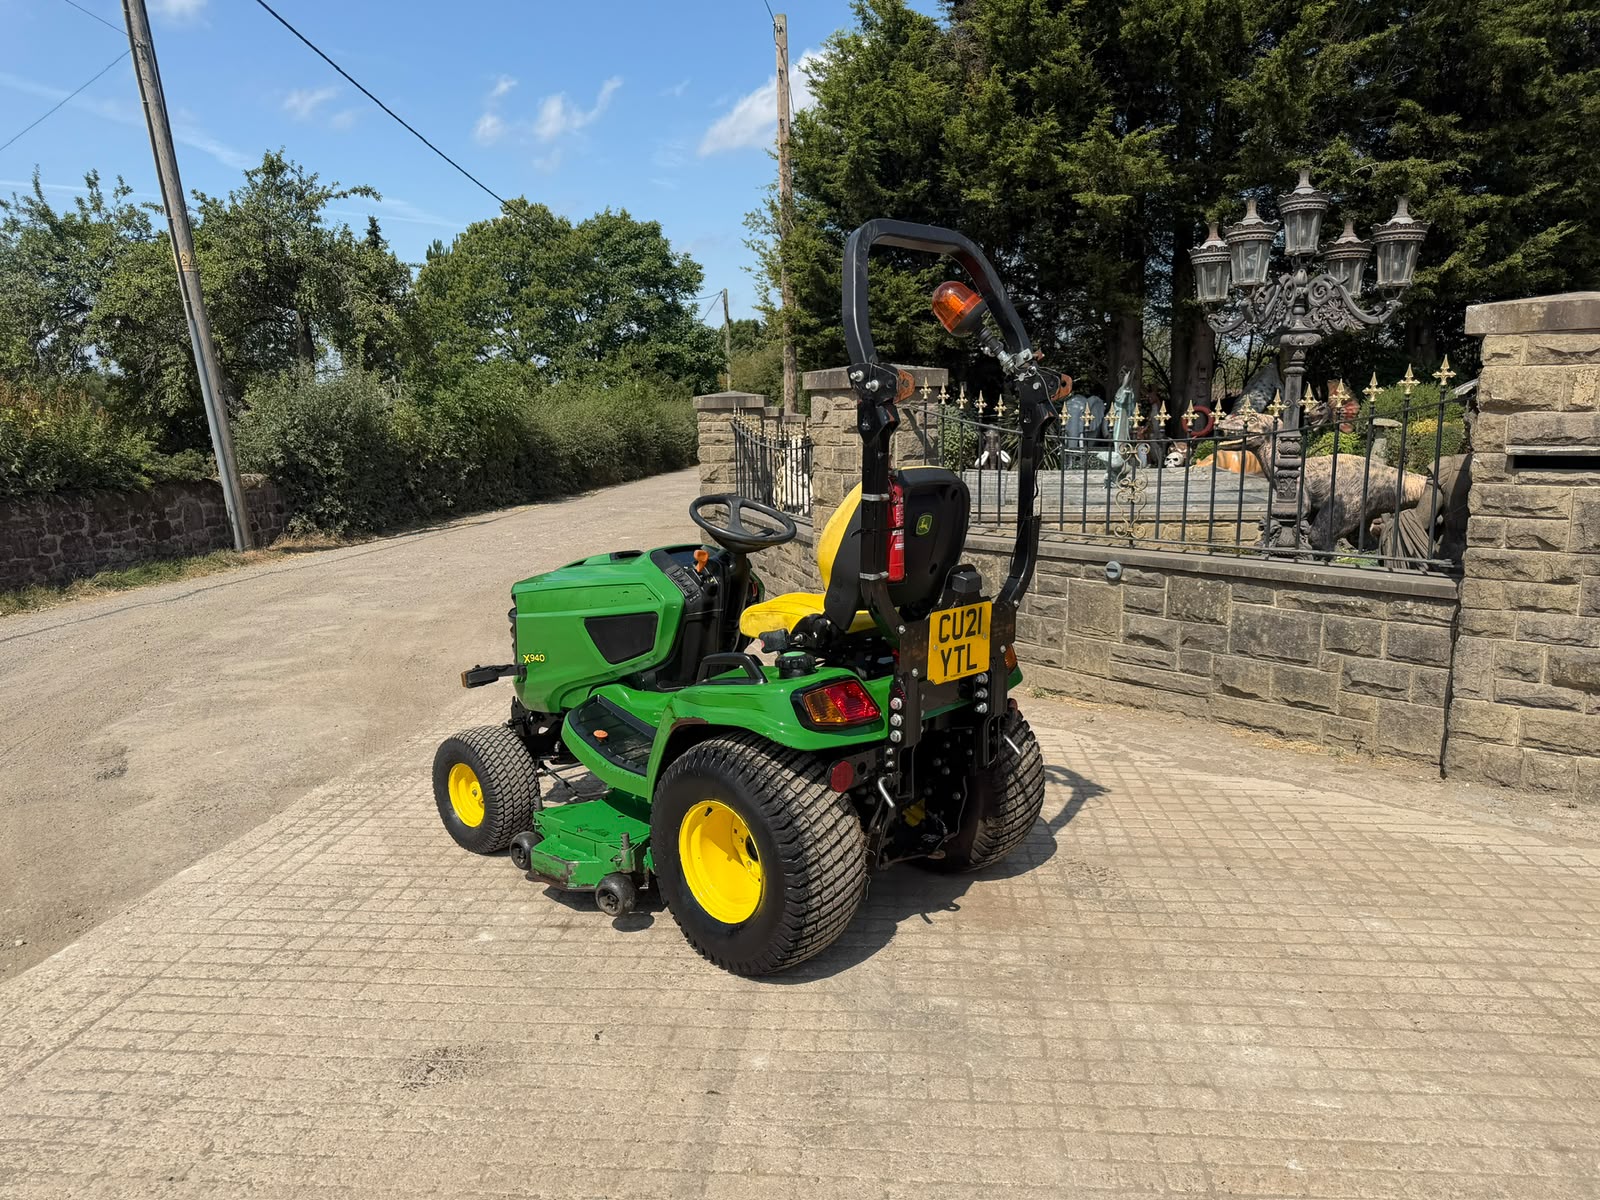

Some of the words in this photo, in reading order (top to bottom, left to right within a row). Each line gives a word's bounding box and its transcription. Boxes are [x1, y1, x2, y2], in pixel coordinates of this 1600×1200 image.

[938, 606, 983, 644] CU21
[522, 653, 546, 664] X940
[940, 643, 978, 677] YTL
